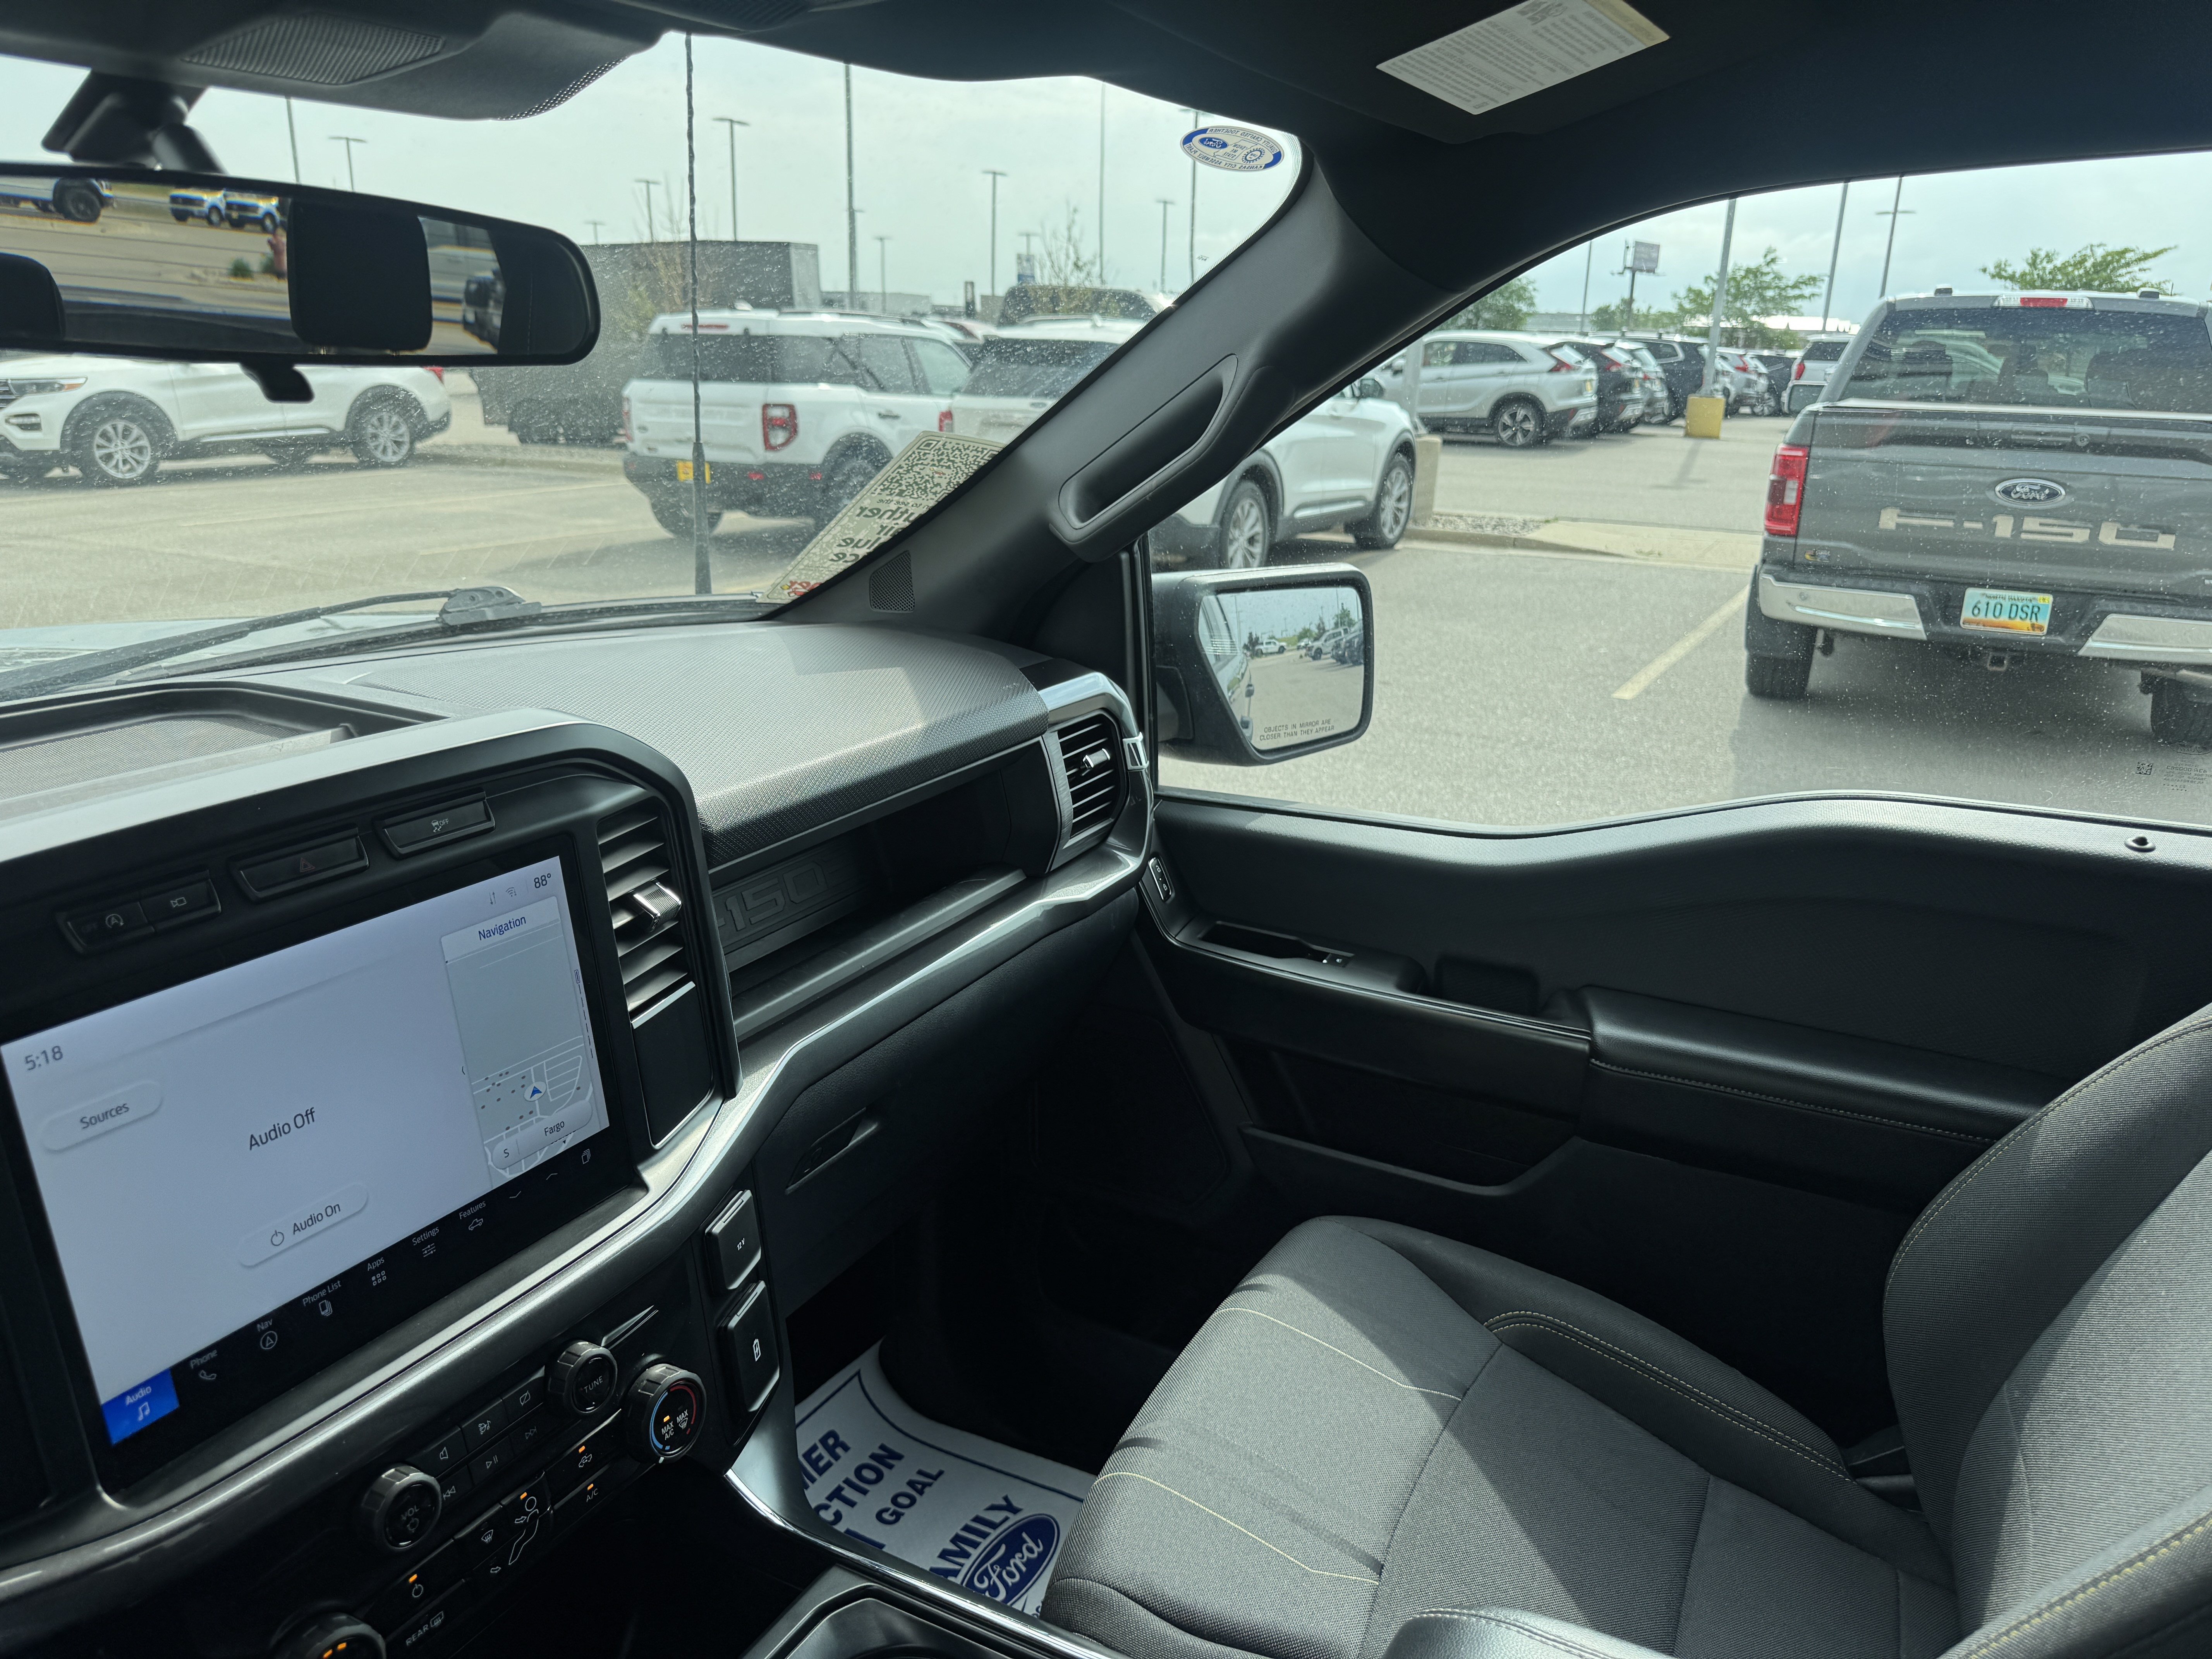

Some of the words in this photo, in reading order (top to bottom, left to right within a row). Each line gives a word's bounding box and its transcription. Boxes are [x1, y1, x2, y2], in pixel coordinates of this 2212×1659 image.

[1972, 600, 2003, 619] 610
[2008, 603, 2040, 622] DSR
[1260, 733, 1281, 741] CLOSER
[1315, 725, 1334, 733] APPEAR
[1264, 725, 1288, 733] OBJECTS
[1299, 720, 1319, 728] MIRROR
[478, 917, 526, 941] Navigation
[25, 1045, 64, 1071] 5:18
[80, 1103, 130, 1129] Sources
[249, 1122, 291, 1151] Audio
[294, 1107, 315, 1129] Off
[544, 1121, 565, 1136] Fargo
[503, 1148, 509, 1158] S
[293, 1212, 323, 1235] Audio
[325, 1204, 341, 1217] On
[459, 1200, 486, 1220] Features
[412, 1226, 440, 1246] Settings
[367, 1256, 385, 1271] Apps
[302, 1289, 327, 1307] Phone
[328, 1280, 342, 1293] List
[256, 1318, 273, 1332] Nav
[189, 1349, 218, 1369] Phone
[584, 1375, 603, 1393] TUNE
[125, 1385, 152, 1407] Audio
[677, 1409, 689, 1424] MAX
[661, 1421, 674, 1435] MAX
[665, 1428, 674, 1440] A/C
[586, 1488, 599, 1503] A/C
[875, 1468, 945, 1525] GOAL
[400, 1504, 420, 1520] VOL
[973, 1531, 1043, 1601] Ford
[405, 1624, 429, 1646] REAR
